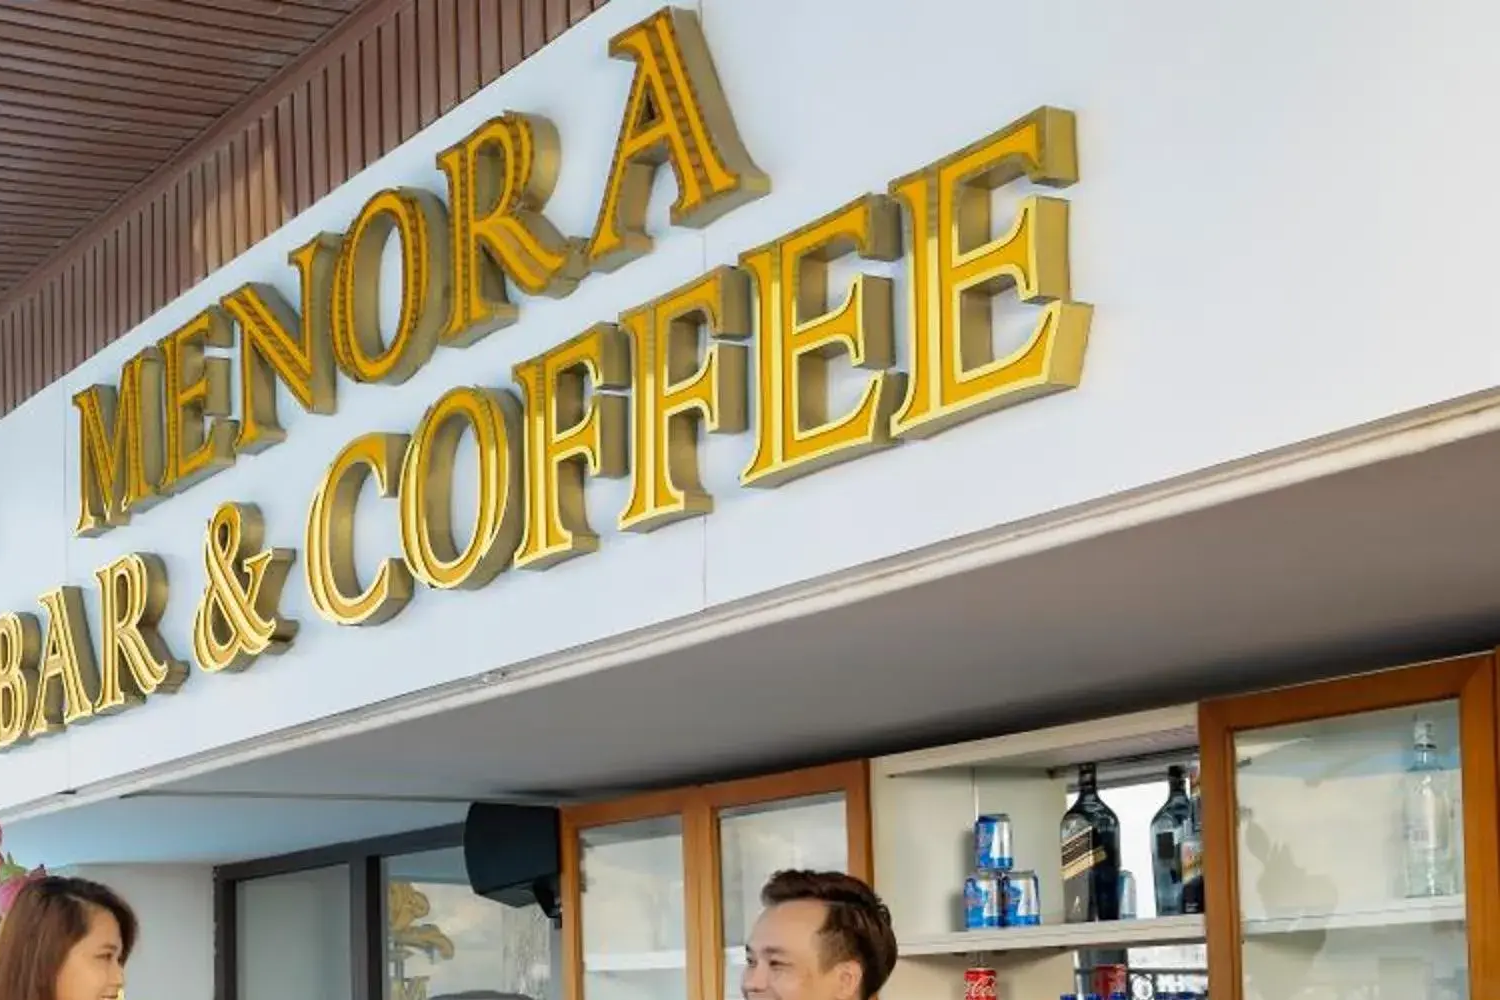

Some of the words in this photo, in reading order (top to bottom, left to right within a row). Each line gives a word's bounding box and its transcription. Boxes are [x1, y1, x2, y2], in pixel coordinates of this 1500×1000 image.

[75, 6, 770, 537] MENORA
[193, 502, 296, 673] &
[307, 104, 1094, 627] COFFEE
